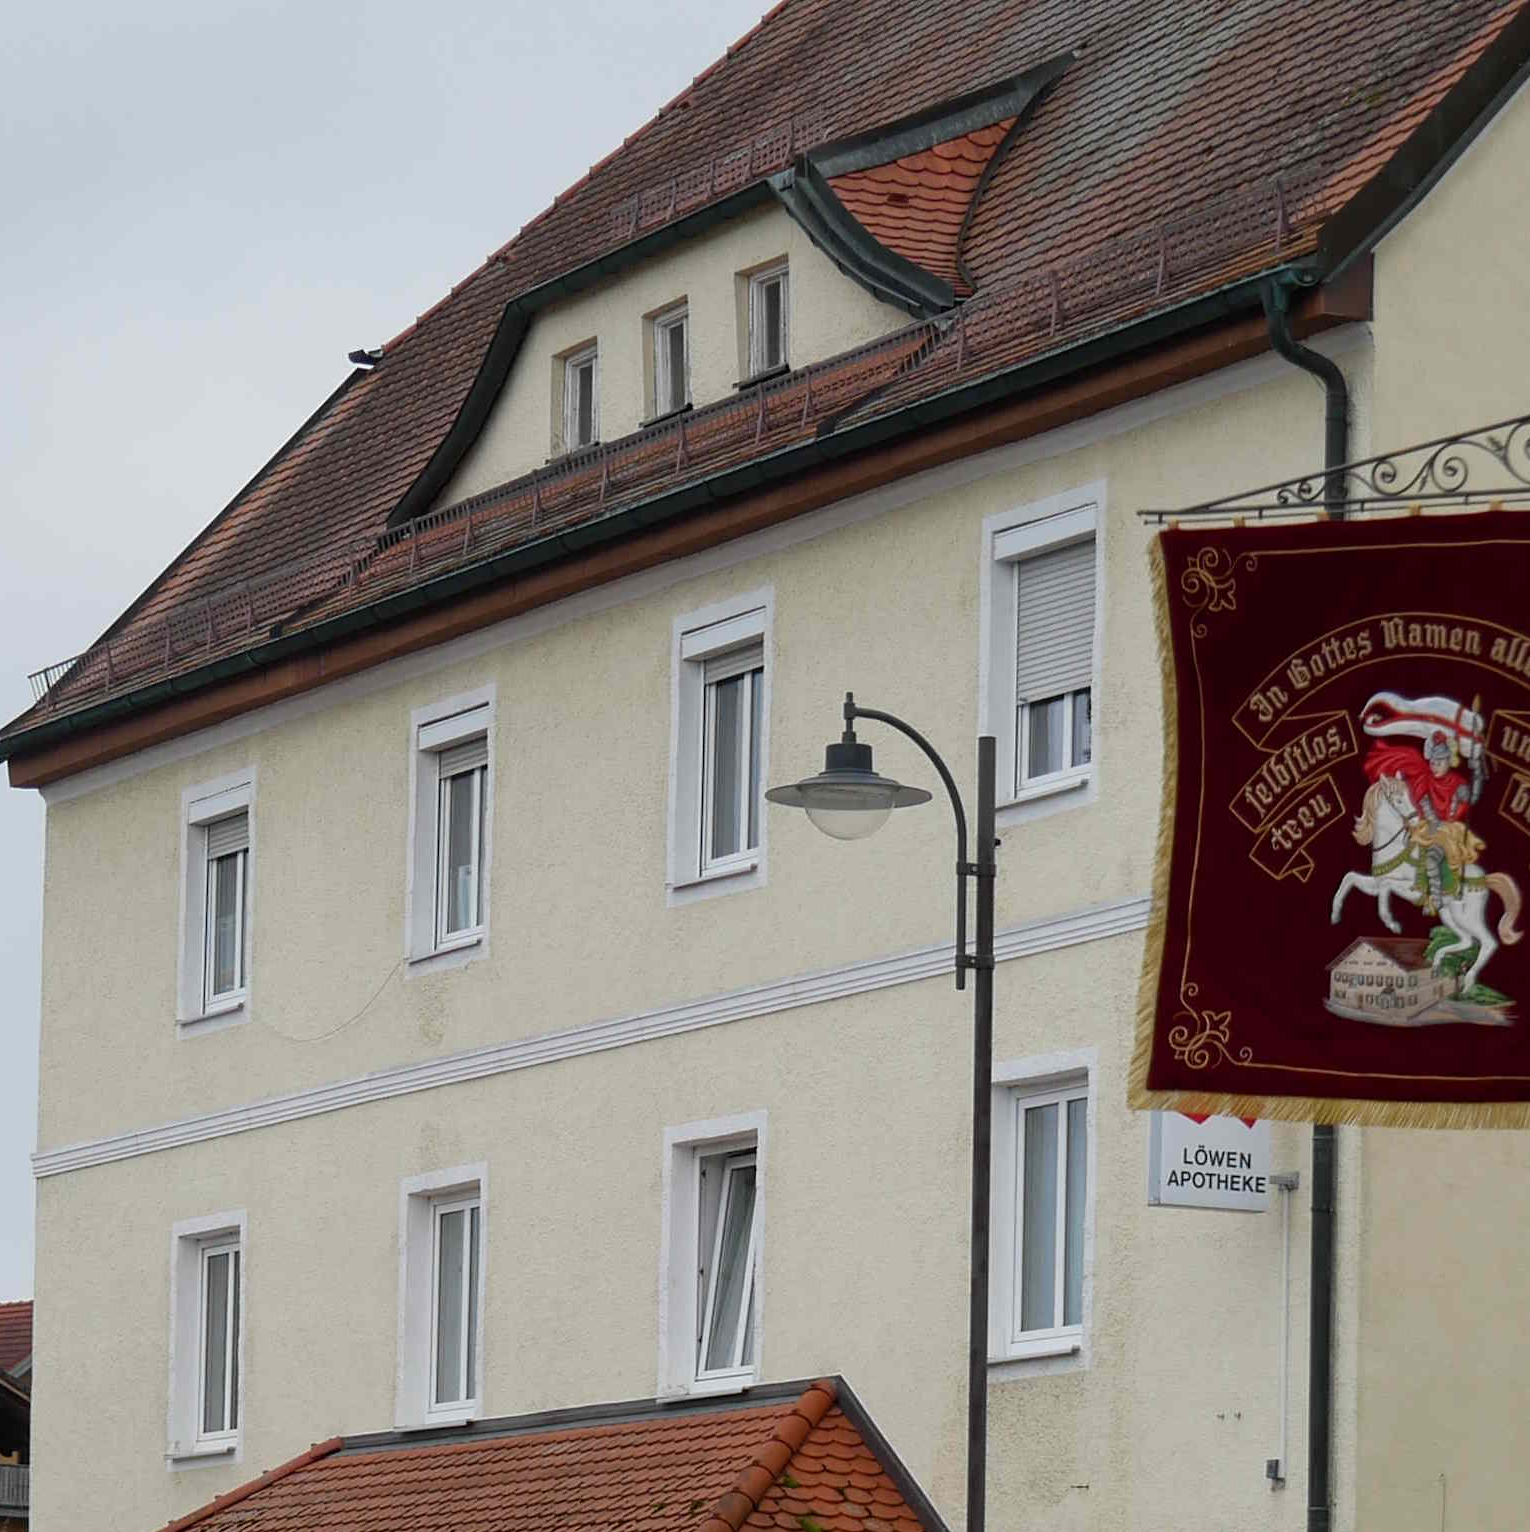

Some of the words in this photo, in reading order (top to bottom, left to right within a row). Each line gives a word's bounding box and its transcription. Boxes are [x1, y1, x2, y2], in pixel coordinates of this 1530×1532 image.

[1249, 685, 1289, 722] In
[1286, 629, 1373, 690] Gottes
[1381, 617, 1481, 655] Namen
[1271, 794, 1332, 850] treu
[1183, 1145, 1252, 1169] LÖWEN
[1167, 1170, 1266, 1193] APOTHEKE
